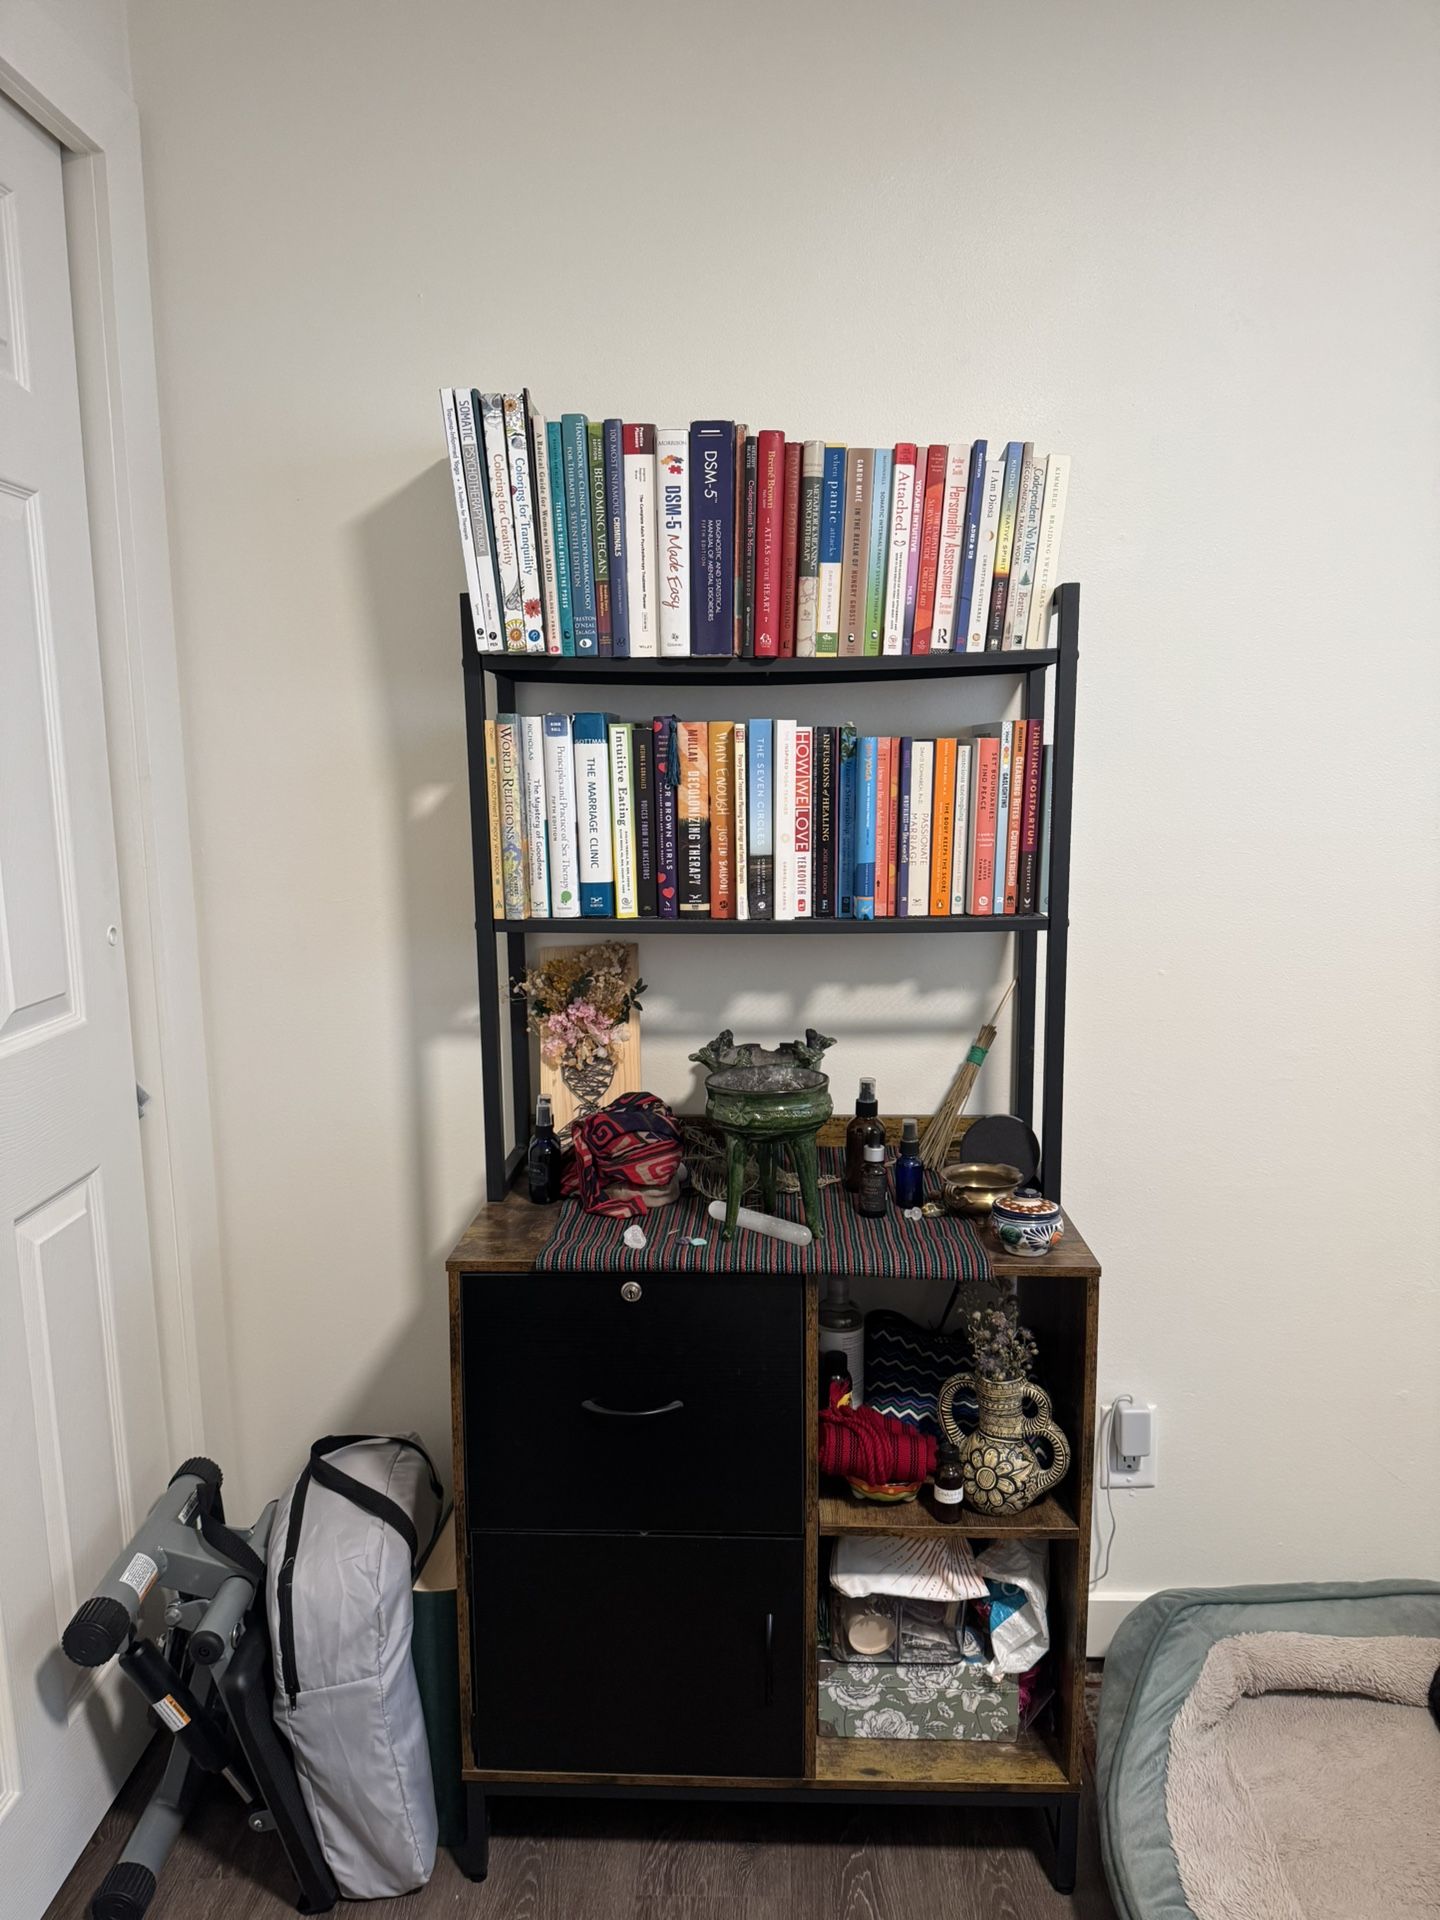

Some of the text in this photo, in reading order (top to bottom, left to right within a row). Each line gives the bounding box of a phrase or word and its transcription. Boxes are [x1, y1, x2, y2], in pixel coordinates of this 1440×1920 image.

[447, 408, 460, 459] Trauma-Informed
[537, 441, 546, 470] Radical
[453, 460, 461, 475] Yoga
[459, 400, 487, 553] SOMATIC PSYCHOTHERAPY TOOLBOX
[611, 444, 619, 468] MOST
[976, 452, 984, 478] ROBERTSON
[539, 472, 548, 494] Guide
[567, 463, 577, 508] THERAPISTS
[594, 467, 607, 531] BECOMING
[612, 471, 621, 515] INFAMOUS
[767, 450, 777, 509] Brené Brown
[990, 476, 1000, 492] Am
[1007, 459, 1018, 499] KINDLING
[1050, 466, 1062, 509] KIMMERER
[493, 453, 513, 566] Coloring for Creativity
[514, 457, 534, 576] Coloring for Tranquility
[541, 496, 549, 507] for
[542, 510, 550, 537] Women
[575, 422, 592, 611] HANDBOOK OF CLINICAL PSYCHOPHARMACOLOGY
[828, 454, 841, 557] when panic attacks
[854, 507, 861, 516] IN
[878, 491, 886, 518] SOMATIC
[893, 470, 912, 537] Attached.
[910, 479, 923, 553] YOU ARE INTUITIVE
[942, 485, 967, 540] Personality
[986, 494, 997, 519] Diosa
[1013, 460, 1031, 566] DECOLONIZING TRAUMA WORK
[1023, 466, 1044, 564] Codependent No More
[571, 511, 579, 549] SEVENTH
[613, 516, 622, 557] CRIMINALS
[764, 526, 772, 556] ATLAS
[803, 489, 813, 564] IN PSYCHOTHERAPY
[853, 518, 861, 530] THE
[1002, 513, 1012, 547] NATIVE
[544, 540, 552, 556] with
[573, 551, 582, 588] EDITION
[597, 534, 609, 574] VEGAN
[662, 485, 684, 610] DSM-5 Made Easy
[707, 549, 714, 559] OF
[714, 519, 722, 614] DIAGNOSTIC AND STATISTICAL
[764, 557, 771, 566] OF
[852, 558, 859, 568] OF
[875, 549, 883, 570] FAMILY
[924, 536, 933, 561] GUIDE
[999, 548, 1008, 572] SPIRIT
[1038, 514, 1056, 609] BRAIDING SWEETGRASS
[850, 570, 859, 598] HUNGRY
[940, 541, 961, 599] Assessment
[763, 583, 771, 613] HEART
[848, 600, 857, 626] GHOSTS
[872, 597, 880, 624] THERAPY
[993, 582, 1004, 631] DENISE LINN
[1015, 591, 1028, 618] Beattie
[615, 730, 627, 783] Intuitive
[714, 732, 730, 816] MAN ENOUGH
[500, 725, 515, 841] WORLD RELIGIONS
[756, 738, 765, 846] THE SEVEN CIRCLES
[796, 732, 810, 851] HOW WE LOVE
[822, 733, 831, 842] INFUSIONS of HEALING
[980, 764, 989, 811] FIND PEACE
[1000, 772, 1010, 809] GASLIGHTING
[1027, 725, 1042, 845] THRIVING POSTPARTUM
[555, 745, 571, 890] Principles and Practice of Sex Therapy
[586, 757, 600, 869] THE MARRIAGE CLINIC
[616, 787, 629, 827] Eating
[664, 783, 674, 871] OR BROWN GIRLS
[687, 729, 702, 885] MULLAN DECOLONIZING THERAPY
[532, 779, 545, 881] The Mystery of Goodness
[910, 812, 918, 867] MARRIAGE
[919, 812, 929, 867] PASSIONATE
[715, 825, 729, 896] JUSTIN BALDONI
[797, 855, 807, 896] YERKOVICH
